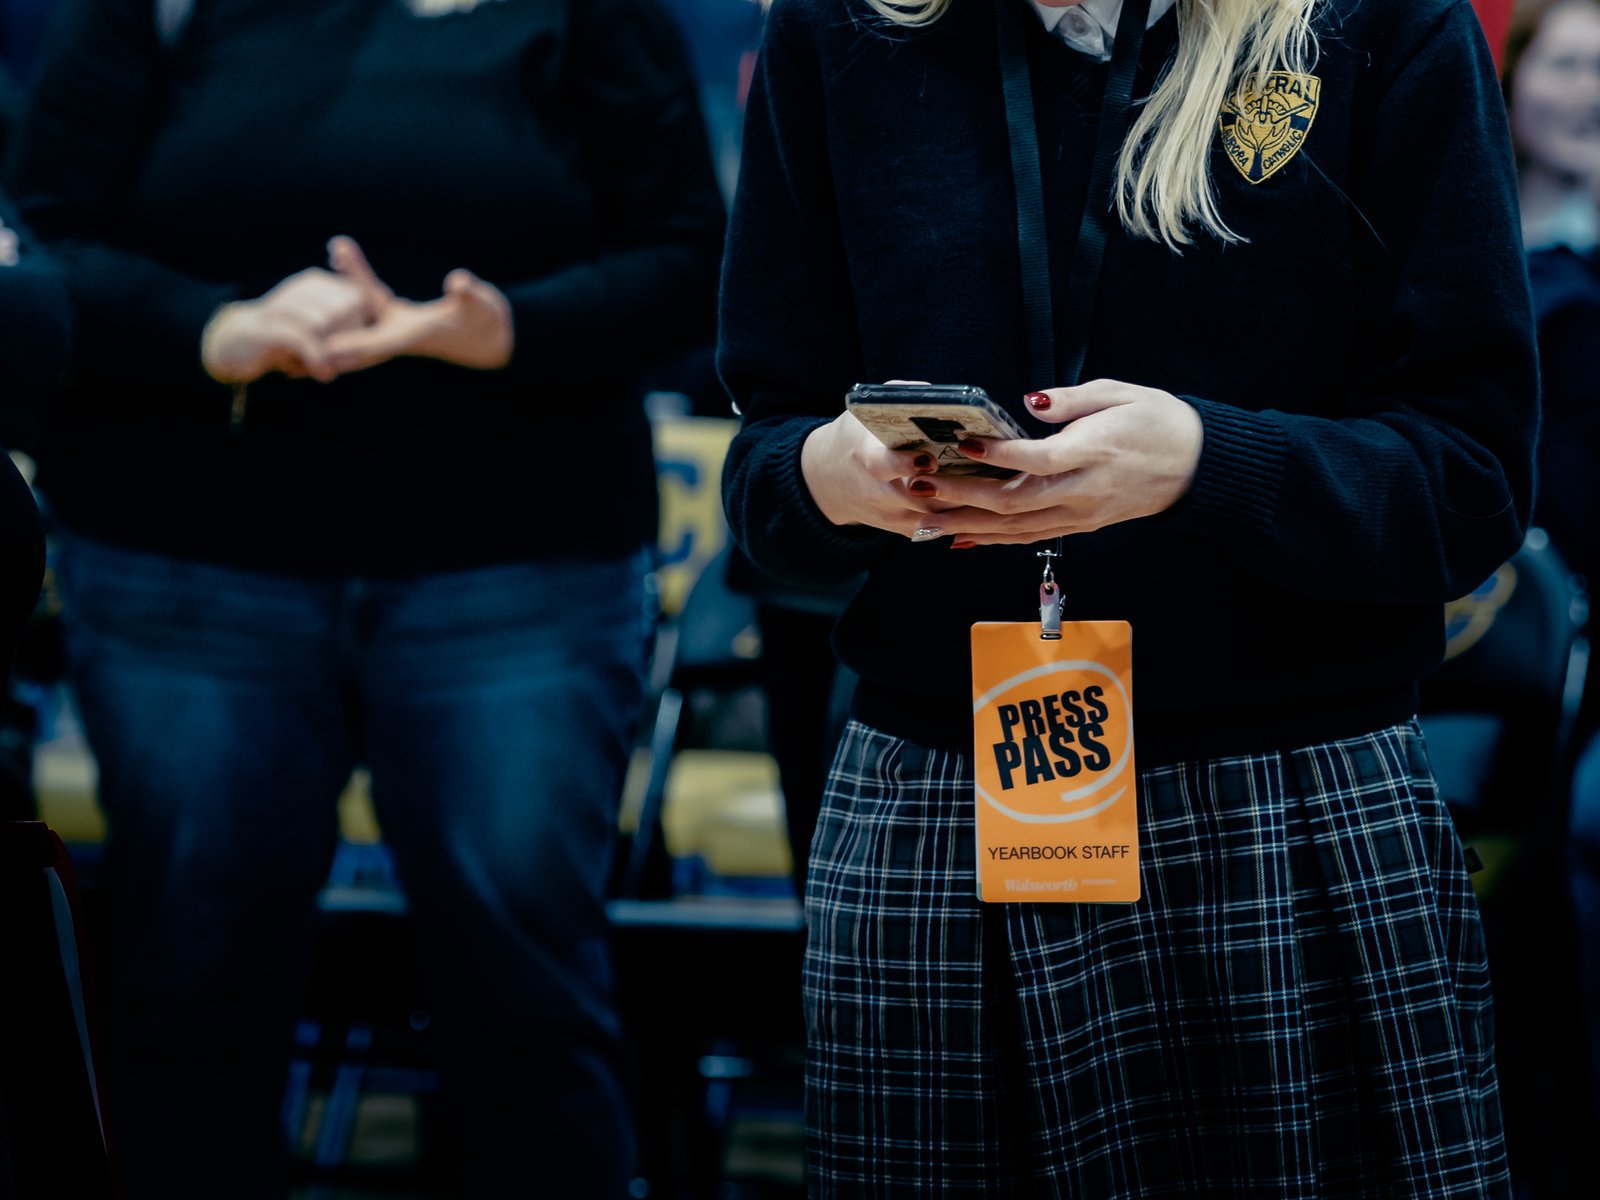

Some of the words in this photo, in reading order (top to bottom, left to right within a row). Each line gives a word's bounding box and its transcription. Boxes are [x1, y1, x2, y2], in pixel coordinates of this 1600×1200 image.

[1263, 130, 1302, 169] CATHOLIC
[997, 685, 1109, 742] PRESS
[992, 722, 1111, 790] PASS
[988, 846, 1078, 860] YEARBOOK
[1082, 845, 1130, 859] STAFF
